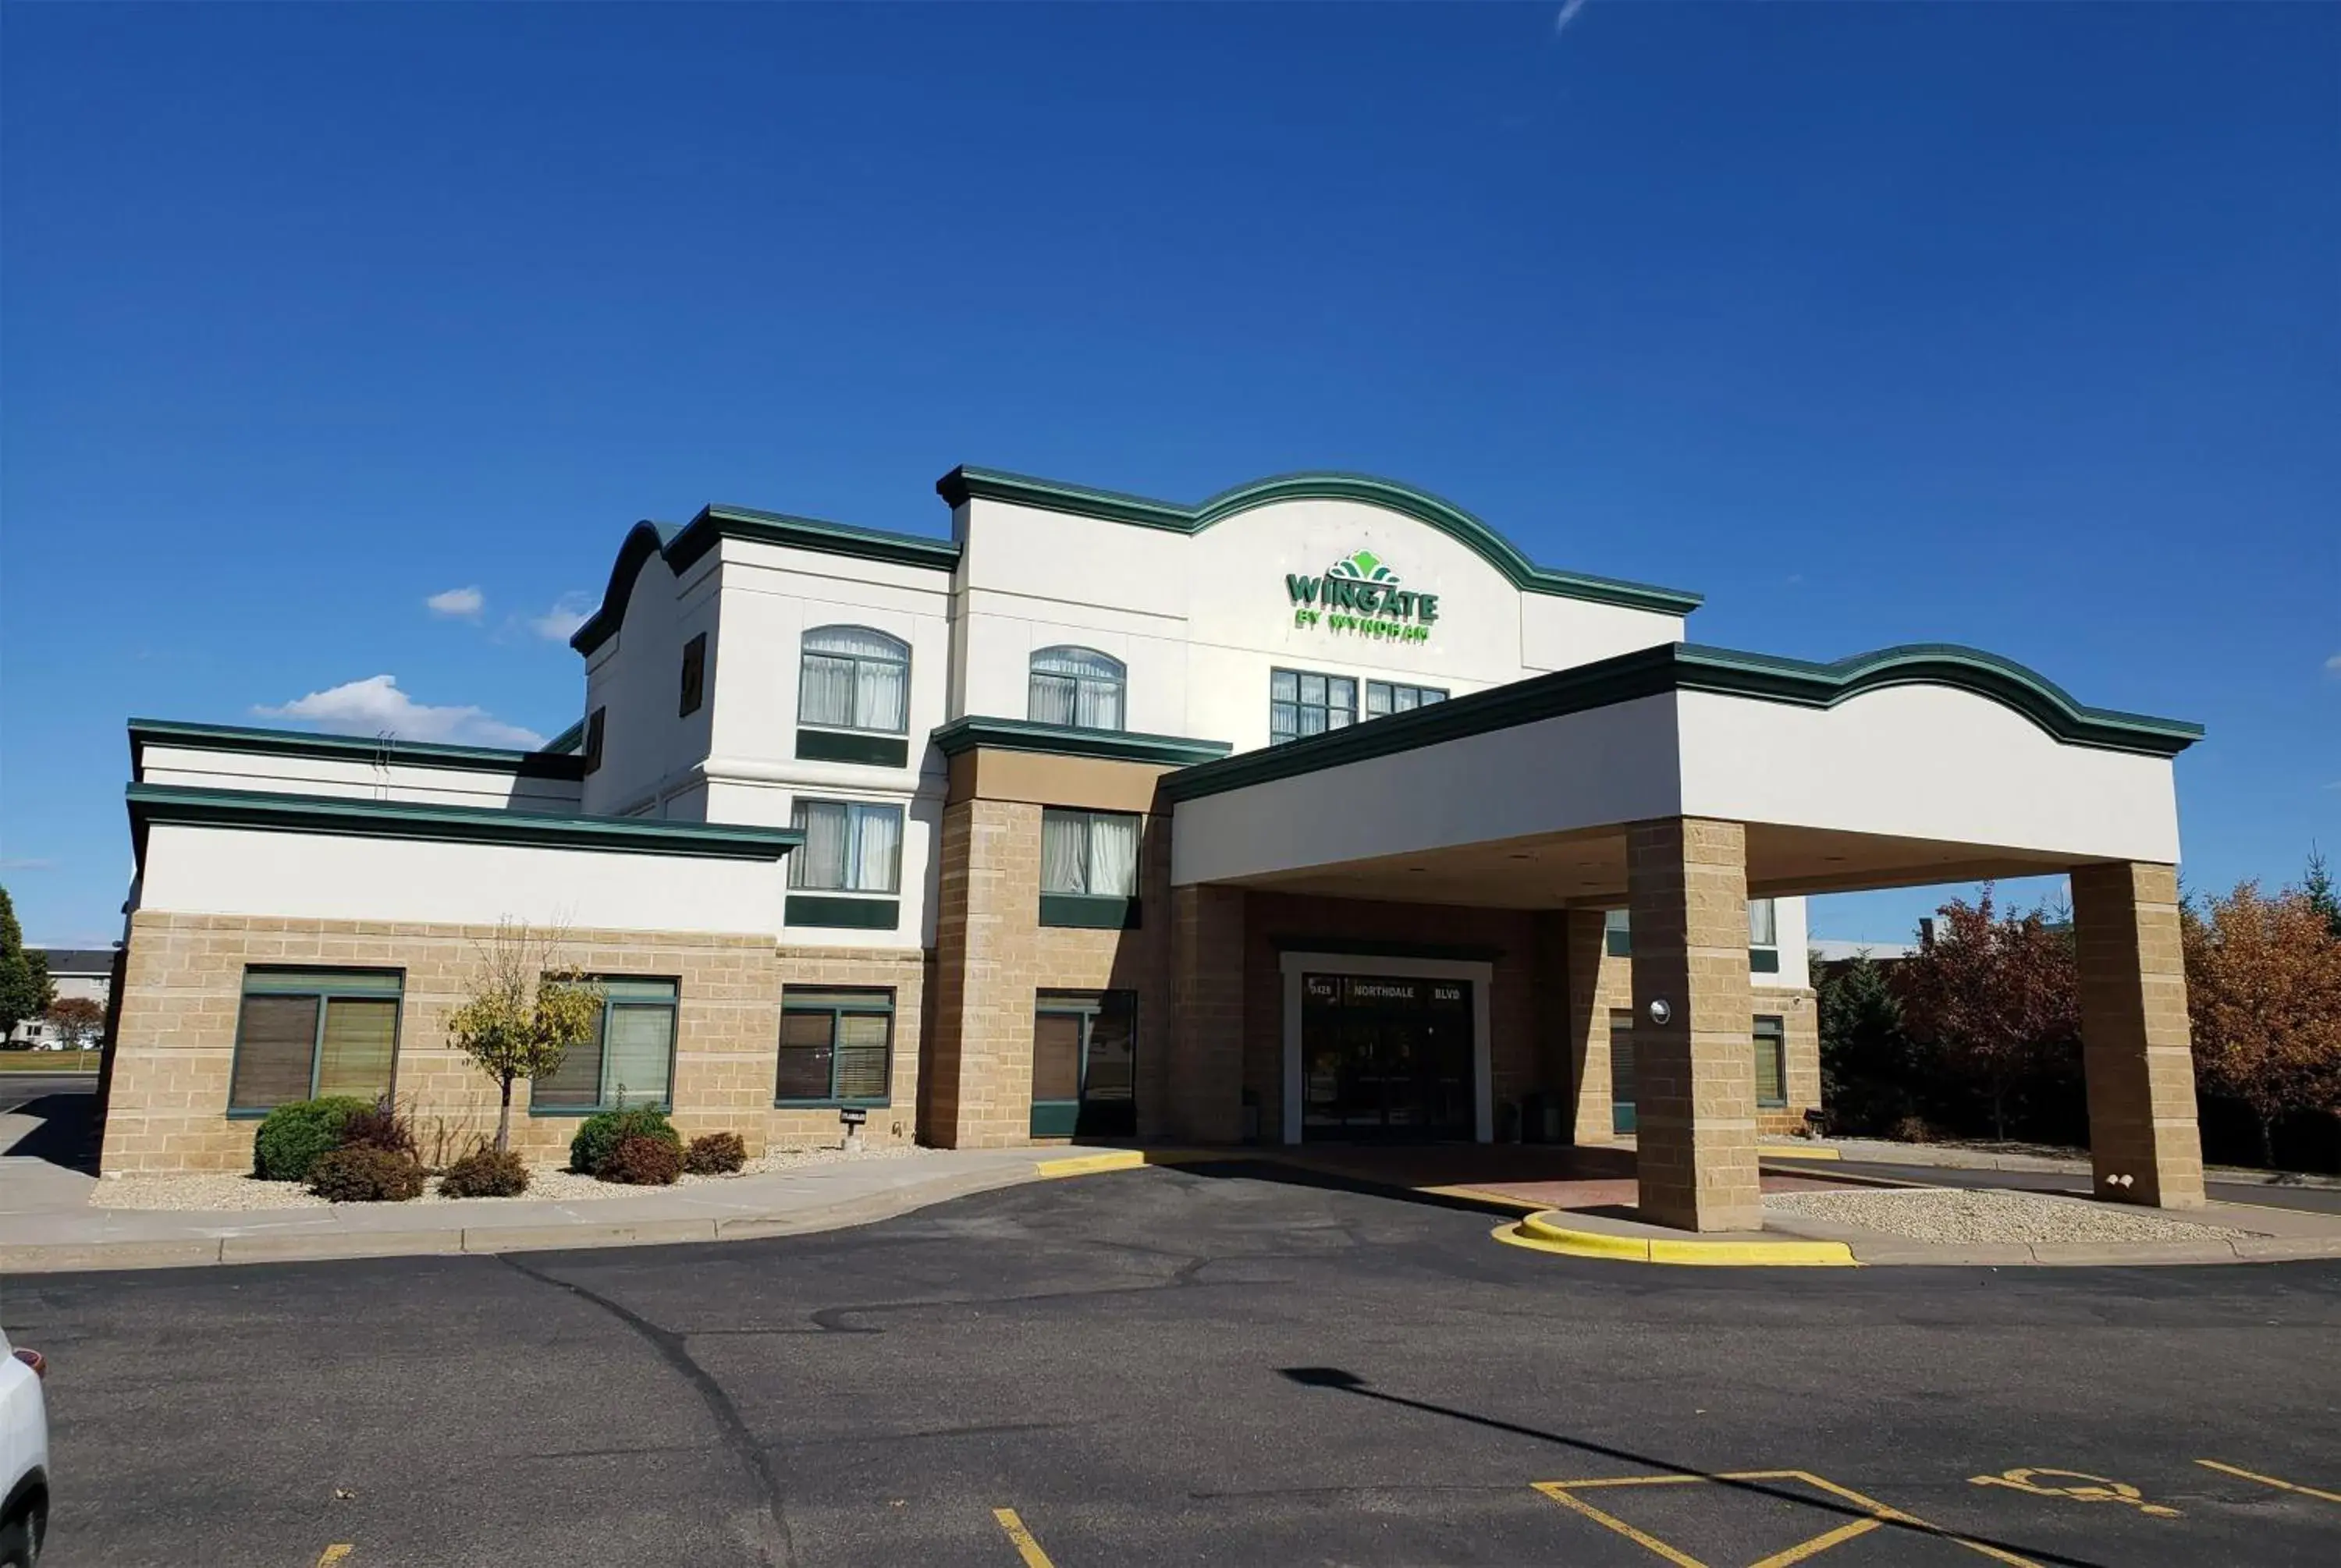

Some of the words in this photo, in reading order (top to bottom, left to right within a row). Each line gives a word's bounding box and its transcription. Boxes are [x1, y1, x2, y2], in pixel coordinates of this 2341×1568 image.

[1286, 573, 1439, 621] WINGATE
[1295, 608, 1321, 626] BY
[1328, 613, 1430, 641] WYNDHAM
[1354, 984, 1415, 998] NORTHDALE
[1435, 988, 1461, 999] BLVD
